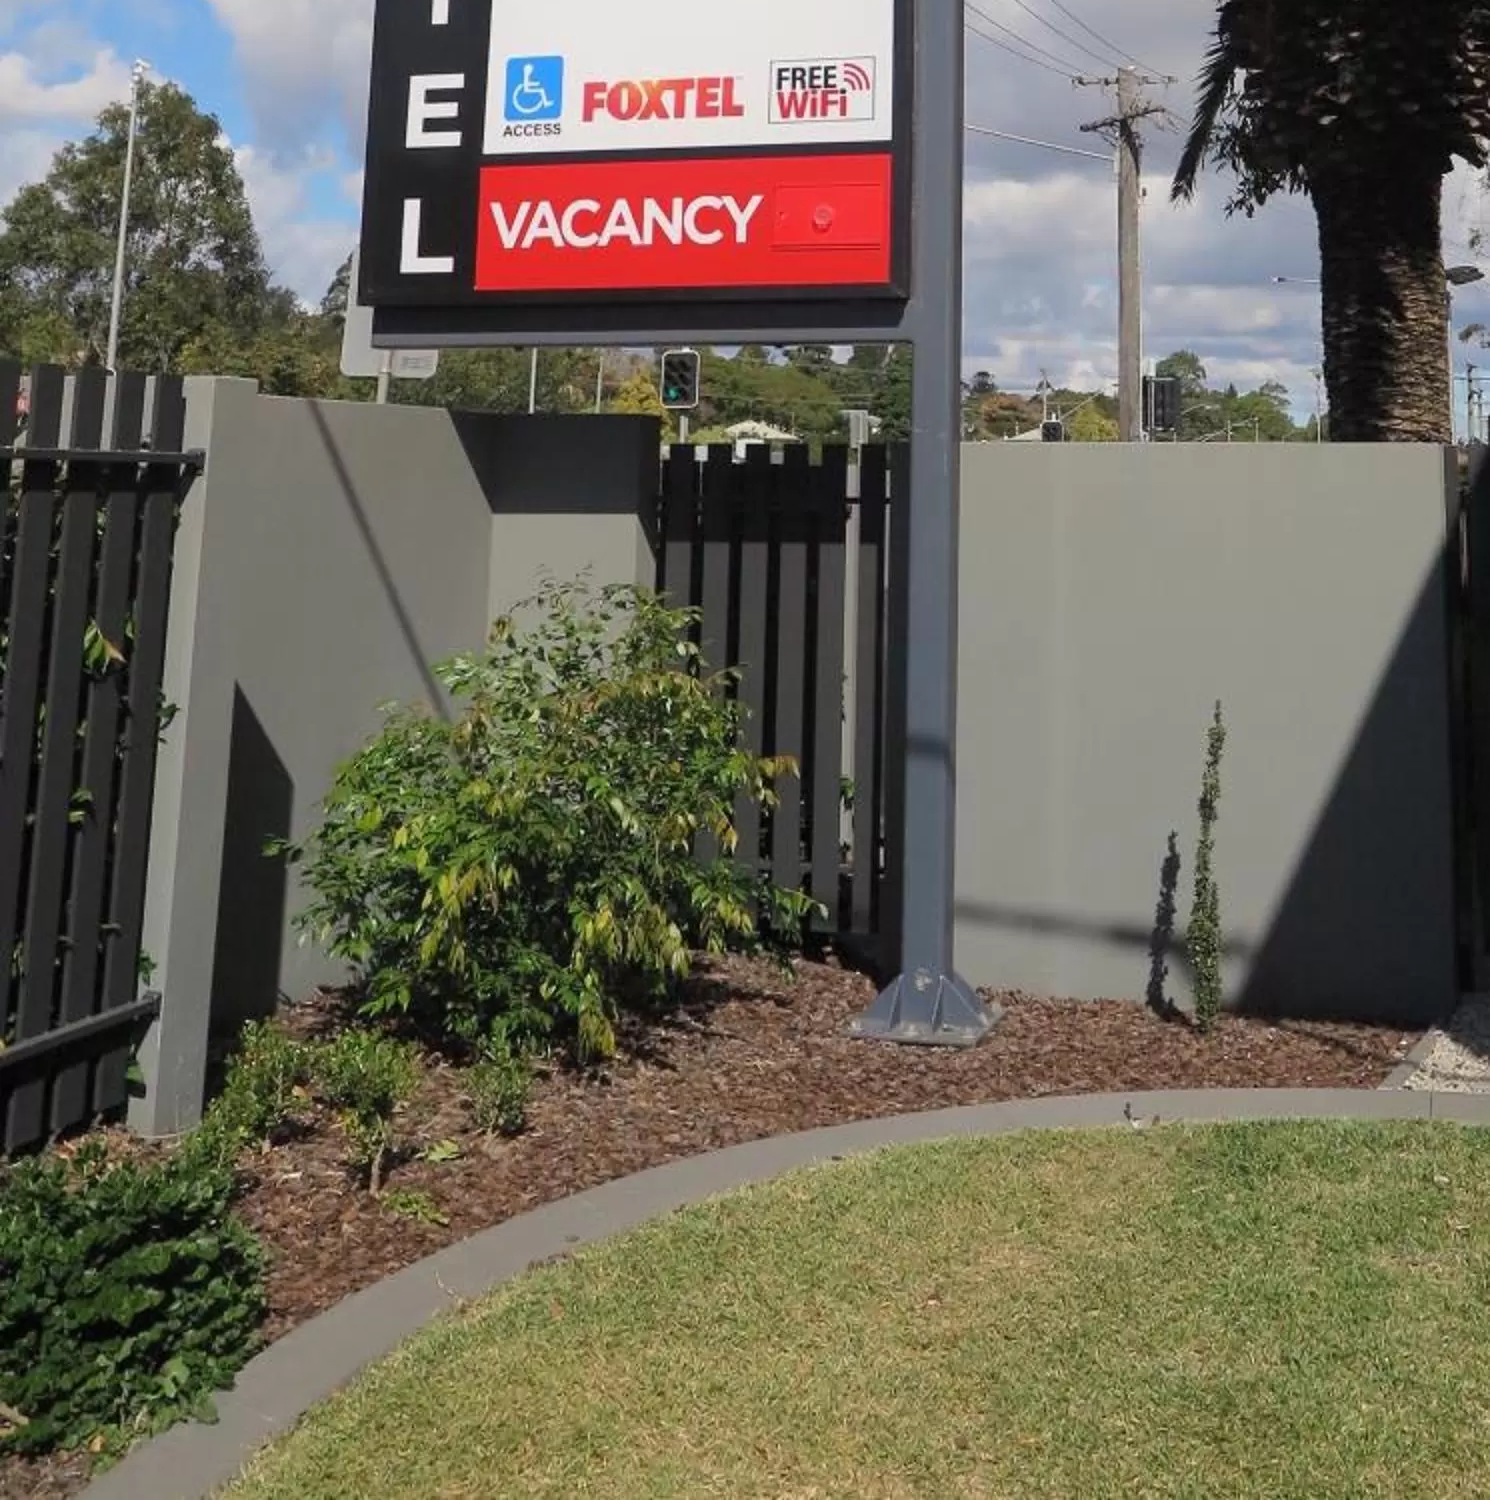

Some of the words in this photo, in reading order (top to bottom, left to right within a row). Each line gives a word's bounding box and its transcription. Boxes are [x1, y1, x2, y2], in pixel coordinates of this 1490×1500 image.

[776, 66, 838, 91] FREE
[581, 77, 744, 123] FOXTEL
[776, 89, 848, 118] WiFi
[502, 122, 562, 138] ACCESS
[489, 195, 764, 249] VACANCY
